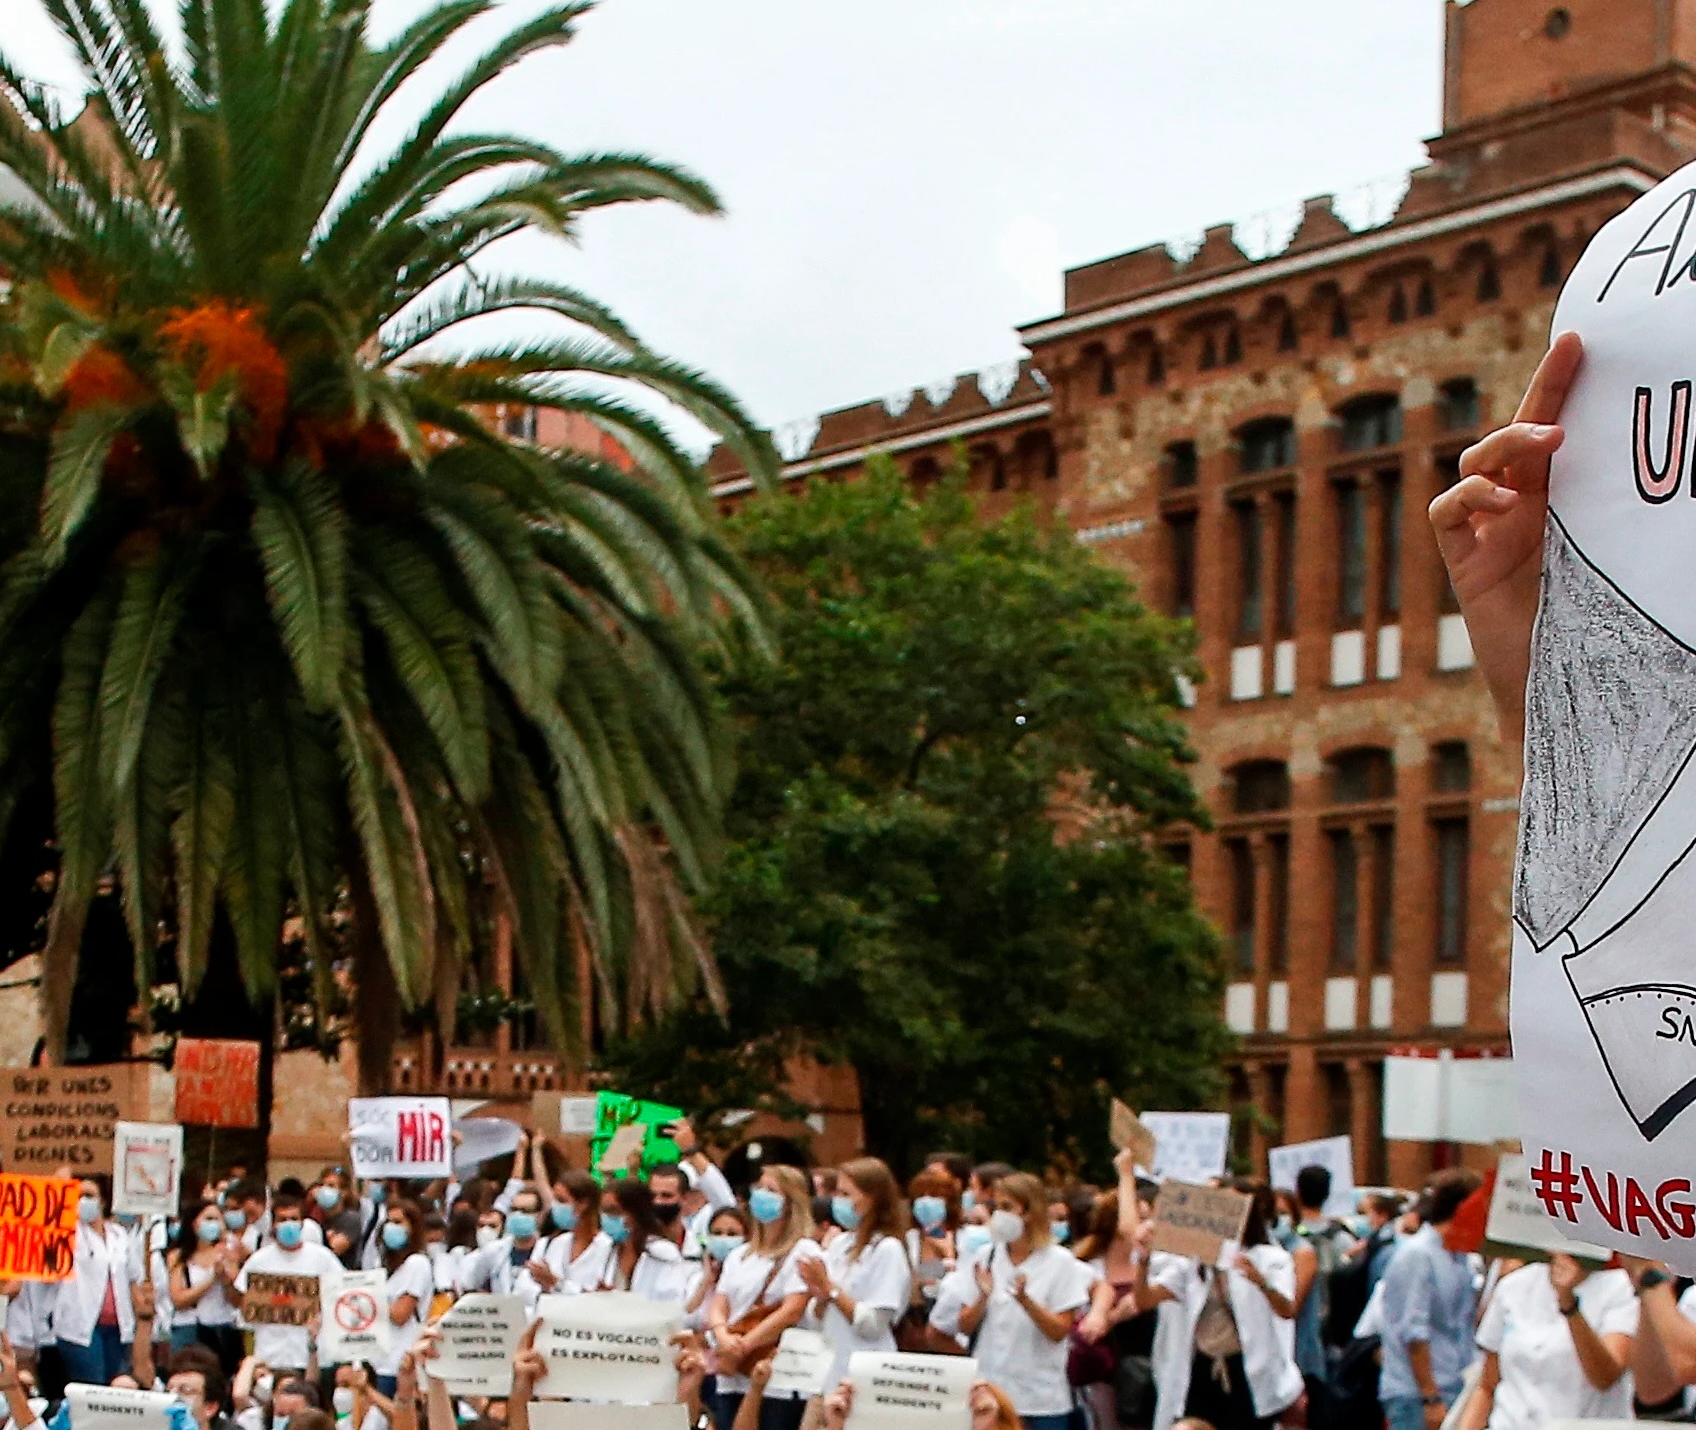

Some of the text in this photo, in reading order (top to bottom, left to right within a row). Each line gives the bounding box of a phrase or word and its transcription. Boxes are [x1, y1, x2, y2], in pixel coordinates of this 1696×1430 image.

[44, 1185, 75, 1228] DE
[553, 1328, 571, 1338] NO
[576, 1330, 591, 1340] ES
[551, 1348, 567, 1358] ES
